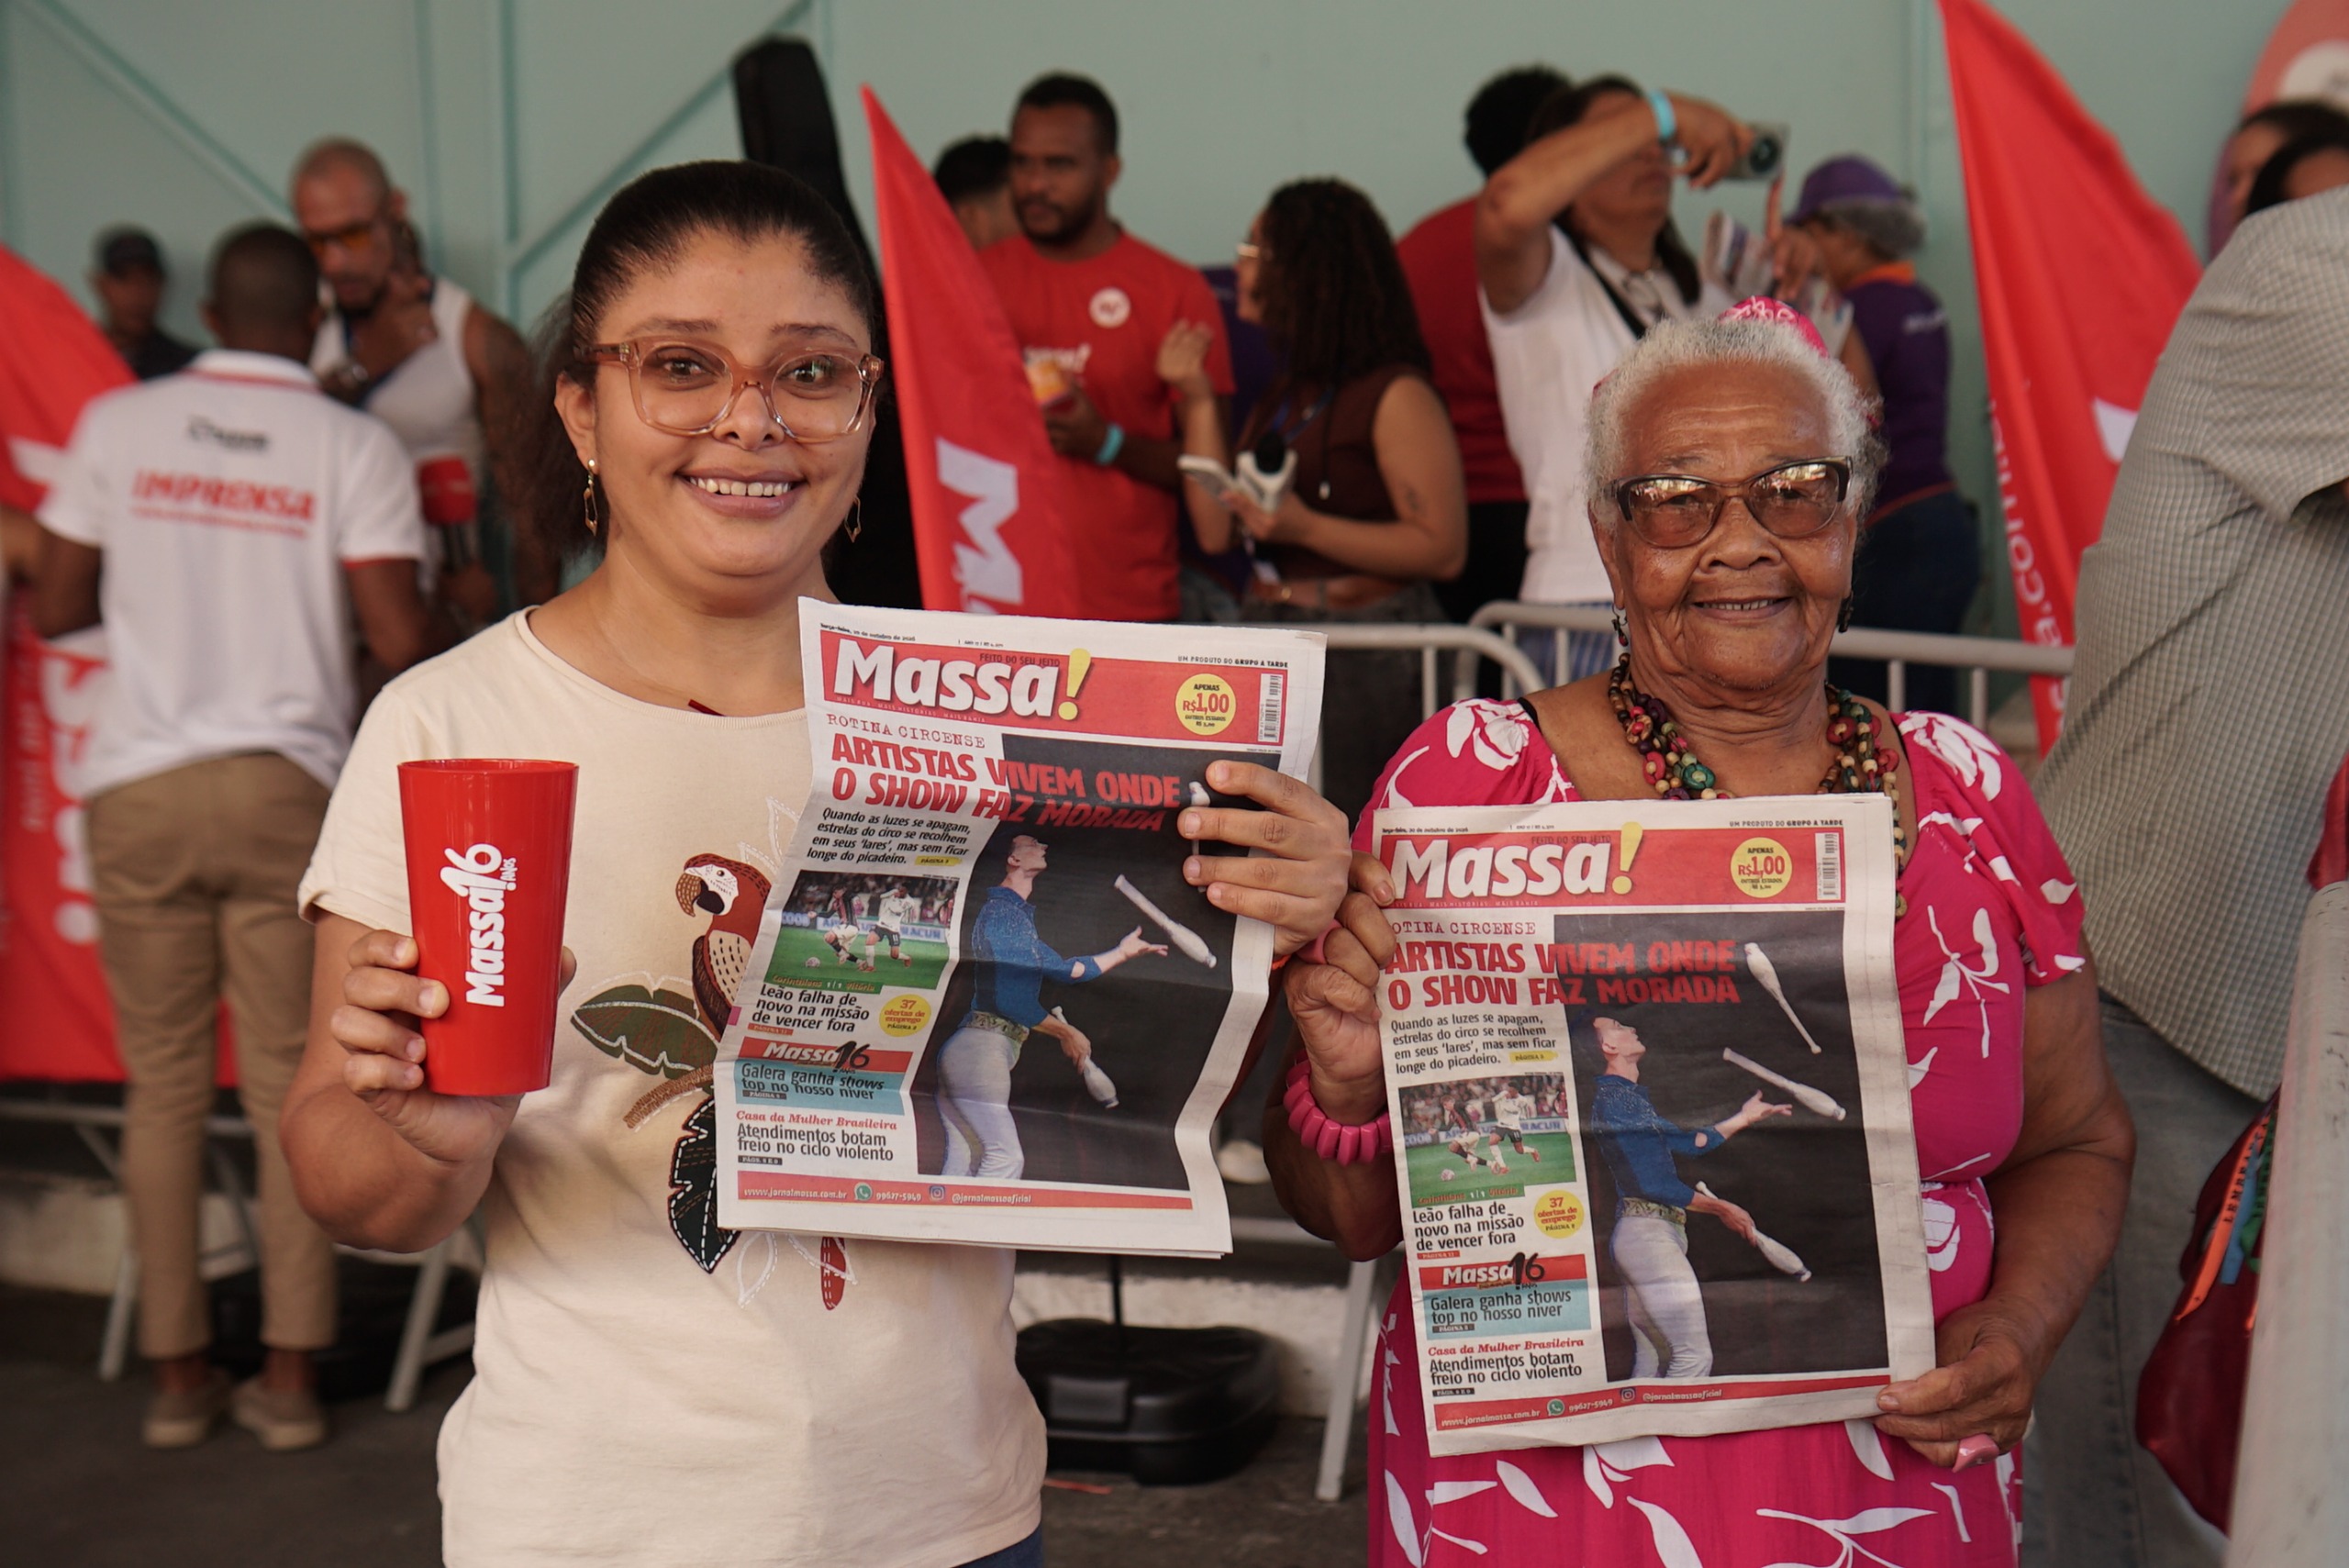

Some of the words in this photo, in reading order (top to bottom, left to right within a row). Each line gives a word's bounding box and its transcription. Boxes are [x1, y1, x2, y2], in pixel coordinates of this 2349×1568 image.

[133, 470, 314, 521] IMPRENSA
[833, 638, 1092, 720] Massa!
[827, 714, 893, 736] ROTINA
[898, 726, 985, 749] CIRCENSE
[831, 733, 977, 782] ARTISTAS
[985, 757, 1085, 798] VIVEM
[1096, 771, 1180, 808] ONDE
[831, 767, 856, 800] O
[865, 774, 968, 814] SHOW
[972, 785, 1034, 823] FAZ
[1037, 798, 1168, 831] MORADA
[823, 807, 865, 823] Quando
[868, 815, 880, 824] as
[883, 815, 909, 828] luzes
[911, 819, 924, 828] se
[926, 819, 971, 834] apagam,
[818, 822, 858, 836] estrelas
[862, 826, 875, 837] do
[878, 828, 902, 839] circo
[918, 831, 967, 844] recolhem
[807, 848, 838, 862] longe
[840, 850, 854, 861] do
[856, 851, 907, 864] picadeiro.
[812, 836, 829, 846] em
[832, 838, 856, 849] seus
[896, 841, 918, 851] mas
[921, 843, 942, 853] sem
[944, 844, 969, 856] ficar
[1389, 821, 1643, 900] Massa!
[1391, 921, 1444, 935] OTINA
[1450, 922, 1536, 935] CIRCENSE
[1385, 940, 1526, 974] ARTISTAS
[1534, 942, 1635, 975] VIVEM
[1647, 940, 1737, 973] ONDE
[760, 984, 793, 1001] Leão
[798, 989, 834, 1005] falha
[839, 993, 856, 1006] de
[1388, 980, 1411, 1010] O
[1422, 975, 1517, 1007] SHOW
[1528, 978, 1587, 1005] FAZ
[1597, 974, 1741, 1004] MORADA
[756, 997, 792, 1015] novo
[797, 1005, 816, 1016] na
[821, 1004, 870, 1020] missão
[885, 1009, 913, 1018] ofertas
[900, 999, 917, 1009] 37
[751, 1010, 771, 1023] de
[775, 1017, 822, 1029] vencer
[827, 1018, 856, 1032] fora
[885, 1016, 921, 1024] emprego
[1391, 1017, 1432, 1032] Quando
[1437, 1016, 1448, 1026] as
[1452, 1014, 1479, 1025] luzes
[1483, 1014, 1494, 1023] se
[1497, 1014, 1543, 1027] apagam,
[1393, 1031, 1433, 1046] estrelas
[1437, 1029, 1451, 1040] do
[1454, 1027, 1479, 1038] circo
[1483, 1027, 1494, 1036] se
[1497, 1027, 1546, 1036] recolhem
[1395, 1050, 1411, 1060] em
[1415, 1046, 1439, 1057] seus
[1483, 1040, 1504, 1051] mas
[1507, 1039, 1529, 1049] sem
[1532, 1038, 1556, 1049] ficar
[1396, 1062, 1426, 1074] longe
[1430, 1058, 1444, 1070] do
[1448, 1054, 1501, 1071] picadeiro.
[741, 1062, 785, 1081] Galera
[791, 1070, 835, 1085] ganha
[840, 1075, 885, 1090] shows
[741, 1078, 765, 1092] top
[771, 1083, 789, 1093] no
[795, 1084, 834, 1096] nosso
[840, 1086, 874, 1100] niver
[736, 1110, 766, 1122] Casa
[770, 1114, 785, 1123] da
[788, 1114, 833, 1126] Mulher
[836, 1117, 897, 1130] Brasileira
[737, 1122, 836, 1143] Atendimentos
[841, 1129, 886, 1146] botam
[738, 1136, 771, 1151] freio
[776, 1142, 795, 1154] no
[800, 1143, 830, 1157] ciclo
[836, 1144, 894, 1161] violento
[1413, 1208, 1443, 1223] Leão
[1449, 1203, 1484, 1220] falha
[1488, 1201, 1506, 1215] de
[1537, 1208, 1565, 1218] ofertas
[1567, 1207, 1577, 1215] de
[1550, 1197, 1564, 1208] 37
[1414, 1224, 1449, 1238] novo
[1454, 1222, 1472, 1233] na
[1477, 1213, 1524, 1231] missão
[1541, 1214, 1576, 1224] emprego
[1416, 1237, 1432, 1251] de
[1437, 1236, 1484, 1248] vencer
[1489, 1231, 1516, 1246] fora
[1431, 1297, 1474, 1311] Galera
[1479, 1293, 1522, 1310] ganha
[1527, 1290, 1571, 1305] shows
[1431, 1311, 1454, 1325] top
[1461, 1310, 1477, 1322] no
[1483, 1308, 1521, 1321] nosso
[1528, 1305, 1563, 1318] niver
[1428, 1347, 1457, 1356] Casa
[1459, 1344, 1474, 1353] da
[1478, 1342, 1521, 1353] Mulher
[1524, 1338, 1585, 1351] Brasileira
[1430, 1355, 1524, 1373] Atendimentos
[1530, 1352, 1574, 1367] botam
[1431, 1371, 1462, 1385] freio
[1468, 1372, 1485, 1384] no
[1491, 1367, 1520, 1381] ciclo
[1525, 1365, 1582, 1380] violento
